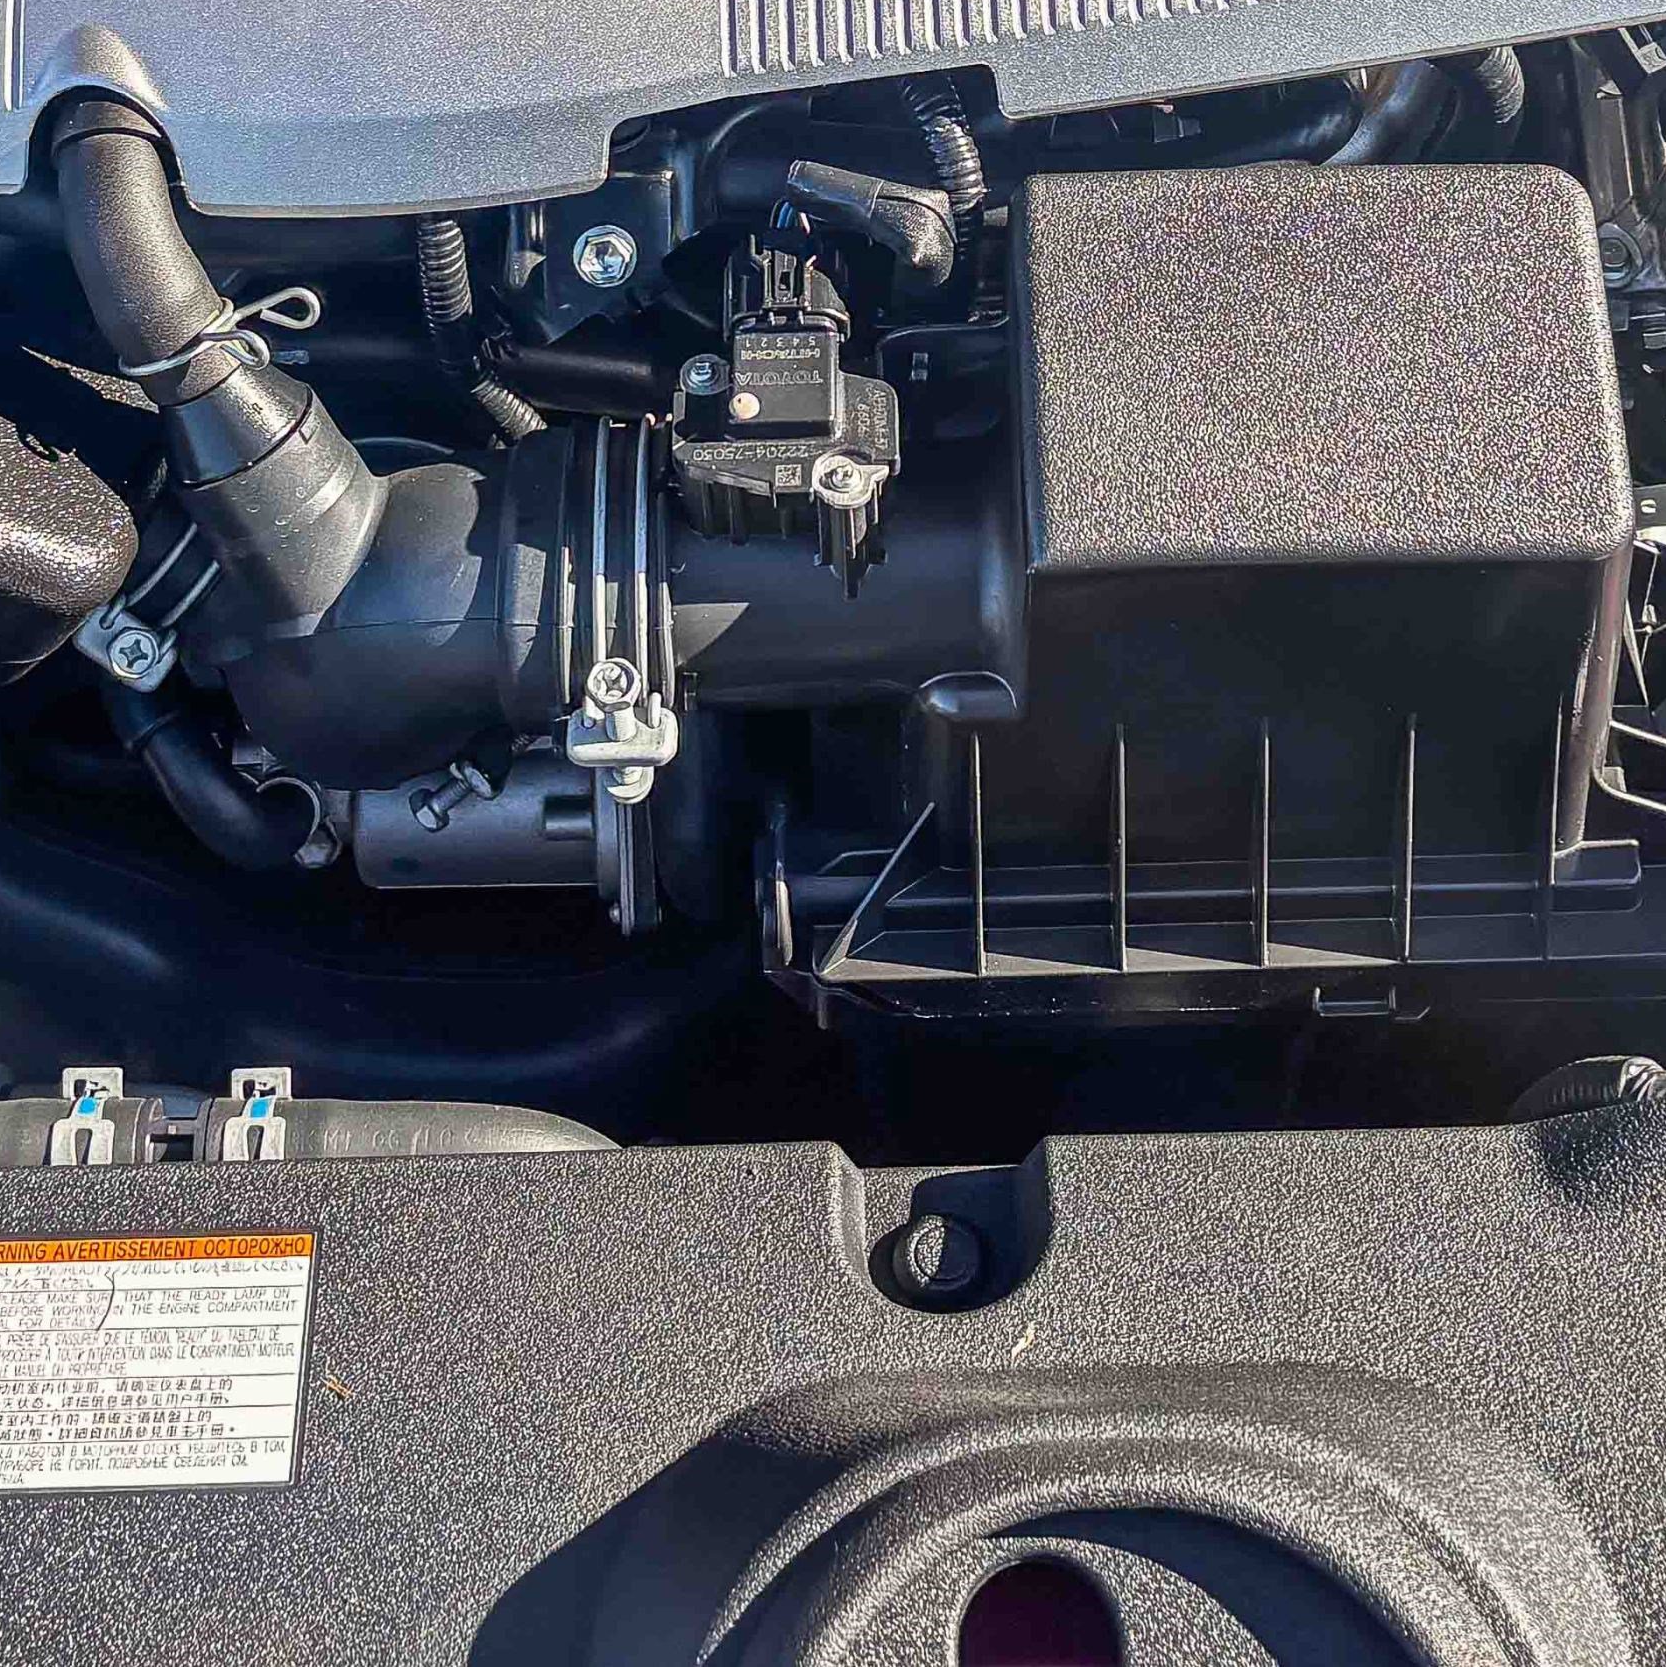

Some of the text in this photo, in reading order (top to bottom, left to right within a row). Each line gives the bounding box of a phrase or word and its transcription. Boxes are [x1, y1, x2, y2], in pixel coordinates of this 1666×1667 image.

[734, 370, 823, 386] TOYOTA
[52, 1239, 197, 1259] AVERTISSEMENT
[203, 1238, 306, 1256] ОСТОРОЖНО
[46, 1292, 78, 1304] MAKE
[188, 1289, 226, 1300] READY
[0, 1305, 44, 1317] BEFORE
[51, 1304, 107, 1316] WORKING
[131, 1303, 154, 1314] THE
